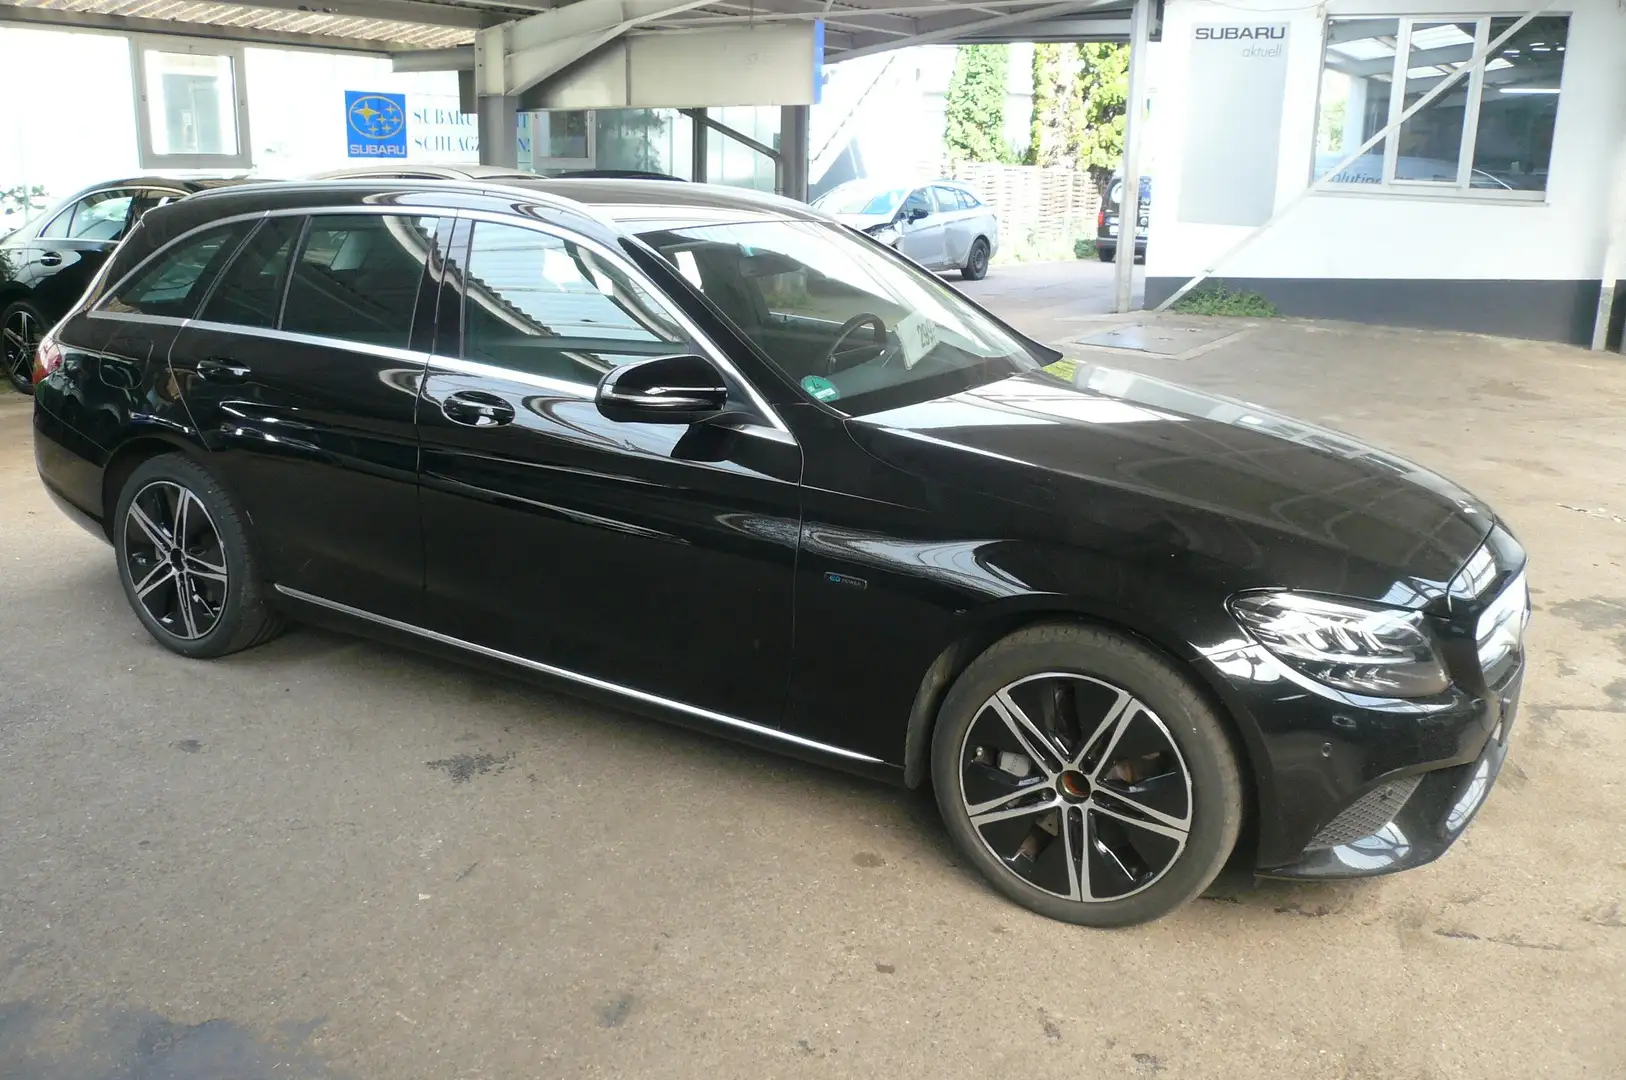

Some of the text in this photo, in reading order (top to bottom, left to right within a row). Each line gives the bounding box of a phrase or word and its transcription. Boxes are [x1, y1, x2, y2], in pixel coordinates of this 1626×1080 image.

[1195, 26, 1285, 40] SUBARU
[1242, 43, 1283, 58] aktuell
[413, 108, 475, 126] SUBARU
[349, 144, 406, 155] SUBARU
